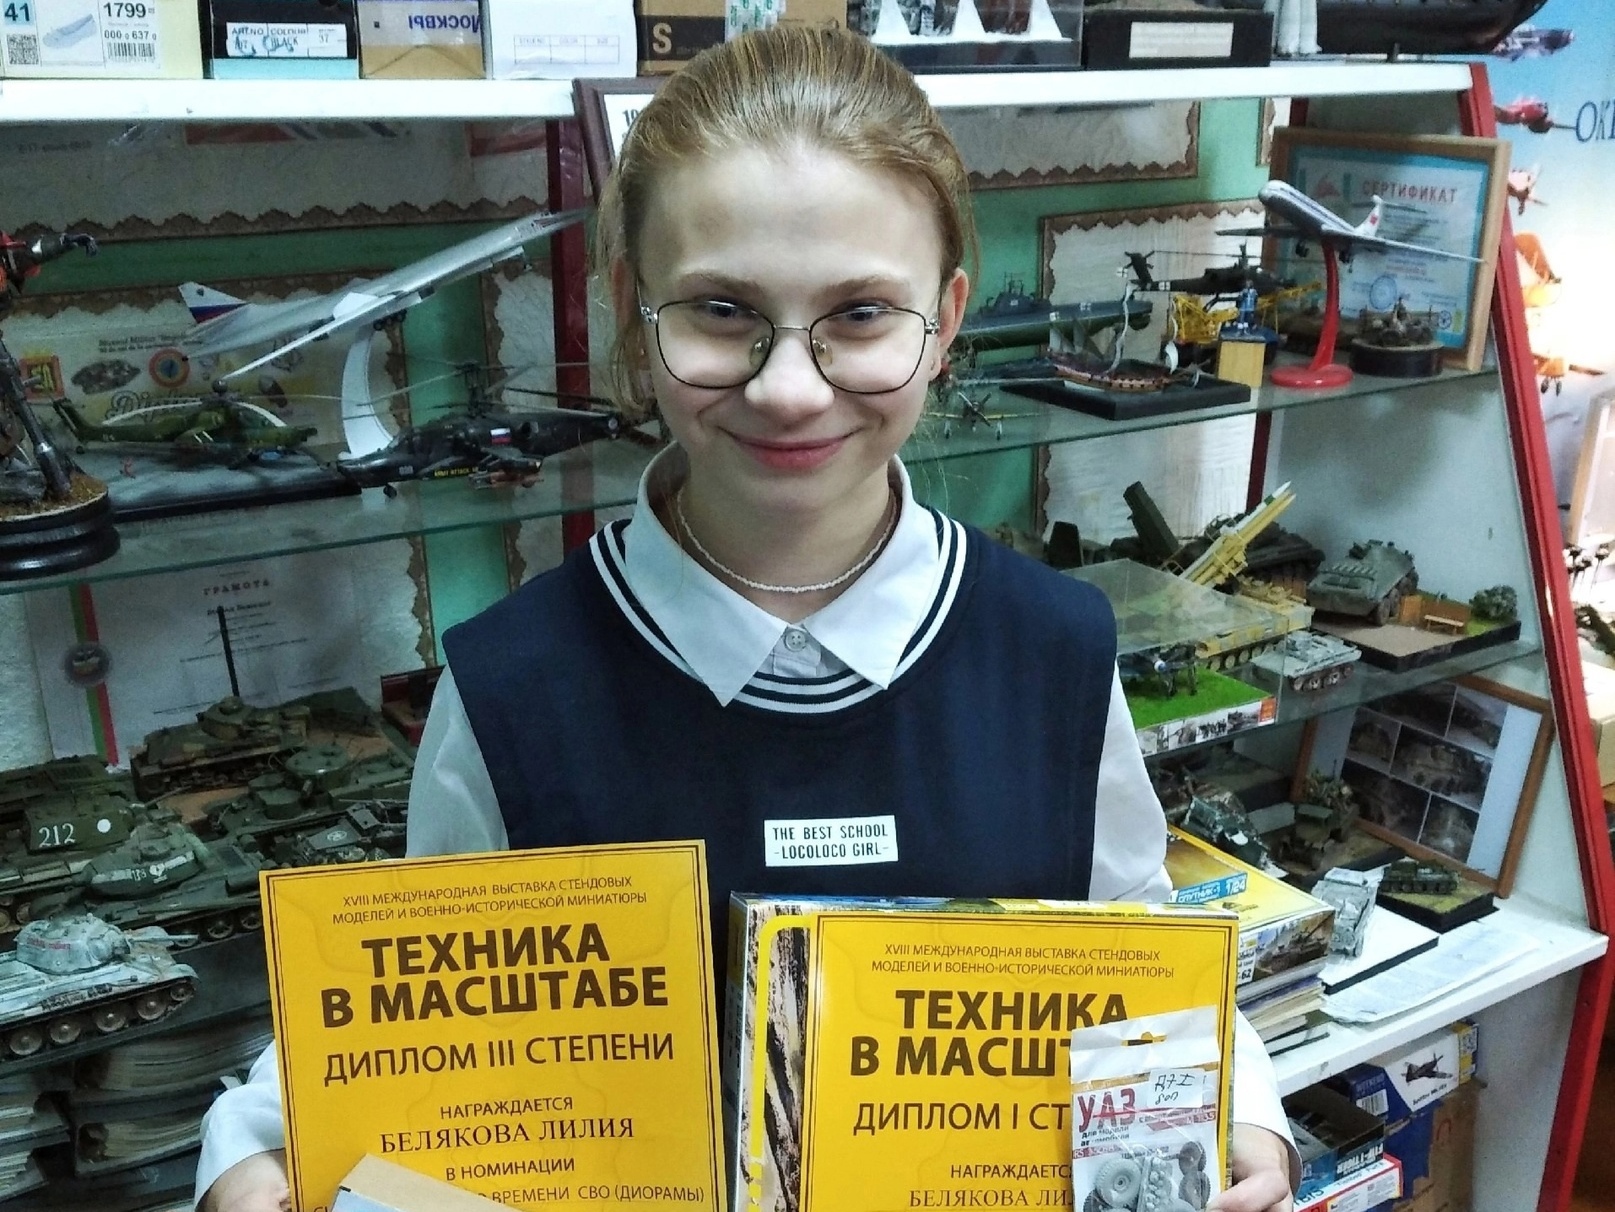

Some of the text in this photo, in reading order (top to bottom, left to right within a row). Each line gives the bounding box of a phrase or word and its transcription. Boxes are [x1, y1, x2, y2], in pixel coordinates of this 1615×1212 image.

[4, 3, 30, 22] 41
[103, 2, 147, 19] 1799
[652, 22, 672, 53] S
[1363, 180, 1458, 204] СЕРТИФИКАТ
[202, 578, 270, 596] ГРАМОТА
[38, 822, 76, 849] 212
[772, 824, 889, 841] THE BEST SCHOOL
[343, 876, 632, 906] XVIII МЕЖДУНАРОДНАЯ ВЫСТАВКА СТЕНДОВЫХ
[332, 891, 647, 925] МОДЕЛЕЙ И ВОЕННО-ИСТОРИЧЕСКОЙ МИНИАТЮРЫ
[361, 922, 611, 978] ТЕХНИКА
[885, 944, 1161, 962] XVIII МЕЖДУНАРОДНАЯ ВЫСТАВКА СТЕНДОВЫХ
[872, 960, 1175, 979] МОДЕЛЕЙ И ВОЕННО-ИСТОРИЧЕСКОЙ МИНИАТЮРЫ
[320, 965, 669, 1028] В МАСШТАБЕ
[895, 989, 1128, 1032] ТЕХНИКА
[323, 1033, 675, 1088] ДИПЛОМ III СТЕПЕНИ
[850, 1035, 880, 1077] В
[440, 1096, 574, 1120] НАГРАЖДАЕТСЯ
[853, 1102, 1000, 1137] ДИПЛОМ
[1012, 1102, 1019, 1130] I
[1077, 1087, 1136, 1133] УАЗ
[380, 1118, 635, 1154] БЕЛЯКОВА ЛИЛИЯ
[446, 1158, 576, 1181] В НОМИНАЦИИ
[950, 1163, 1072, 1180] НАГРАЖДАЕТС
[492, 1186, 570, 1204] ВРЕМЕНИ
[578, 1186, 610, 1199] СВО
[614, 1184, 705, 1203] (ДИОРАМЫ)
[910, 1188, 1071, 1208] БЕЛЯКОВА ЛИ
